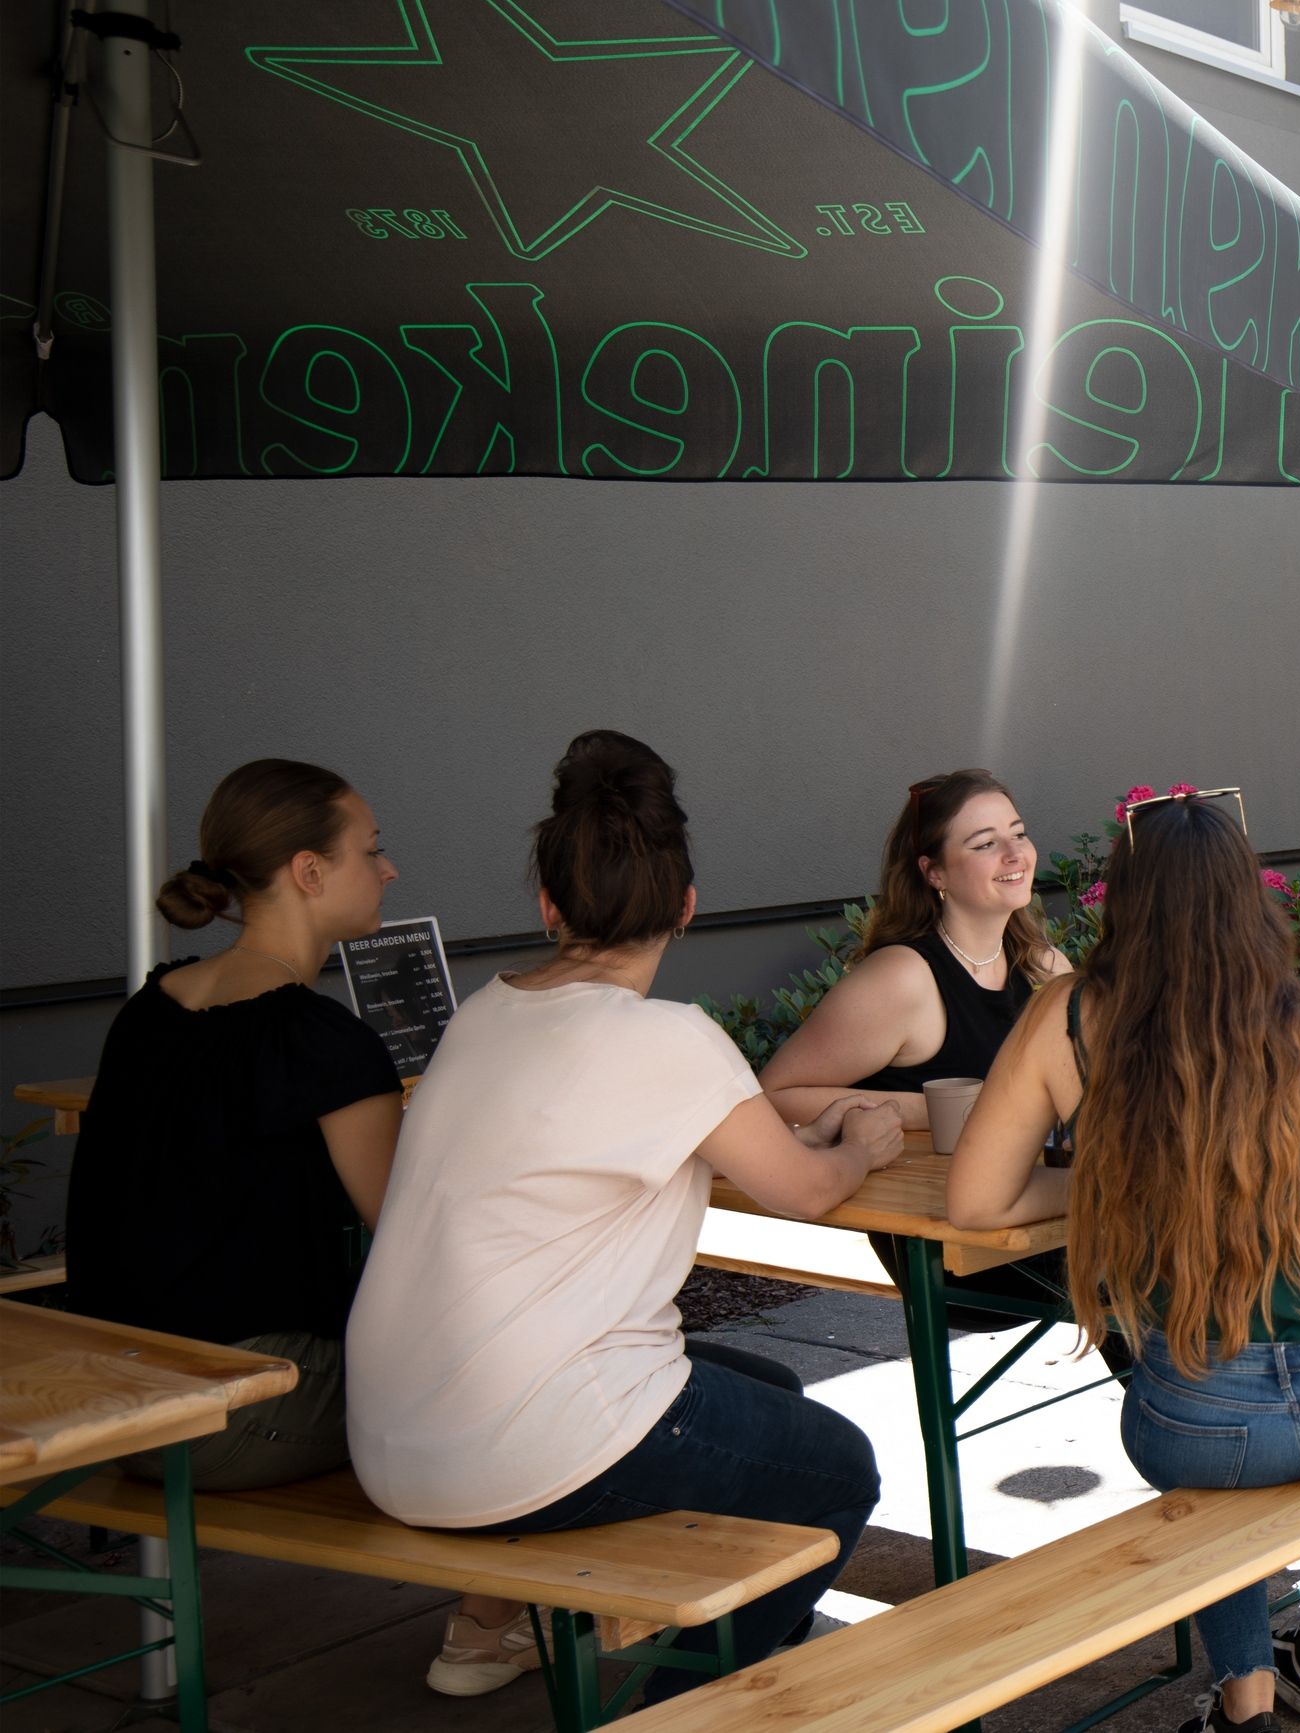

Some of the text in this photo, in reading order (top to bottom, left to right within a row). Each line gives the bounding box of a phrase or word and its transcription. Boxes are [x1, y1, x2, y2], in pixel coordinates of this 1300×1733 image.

[349, 931, 431, 951] BEER GARDEN MENU
